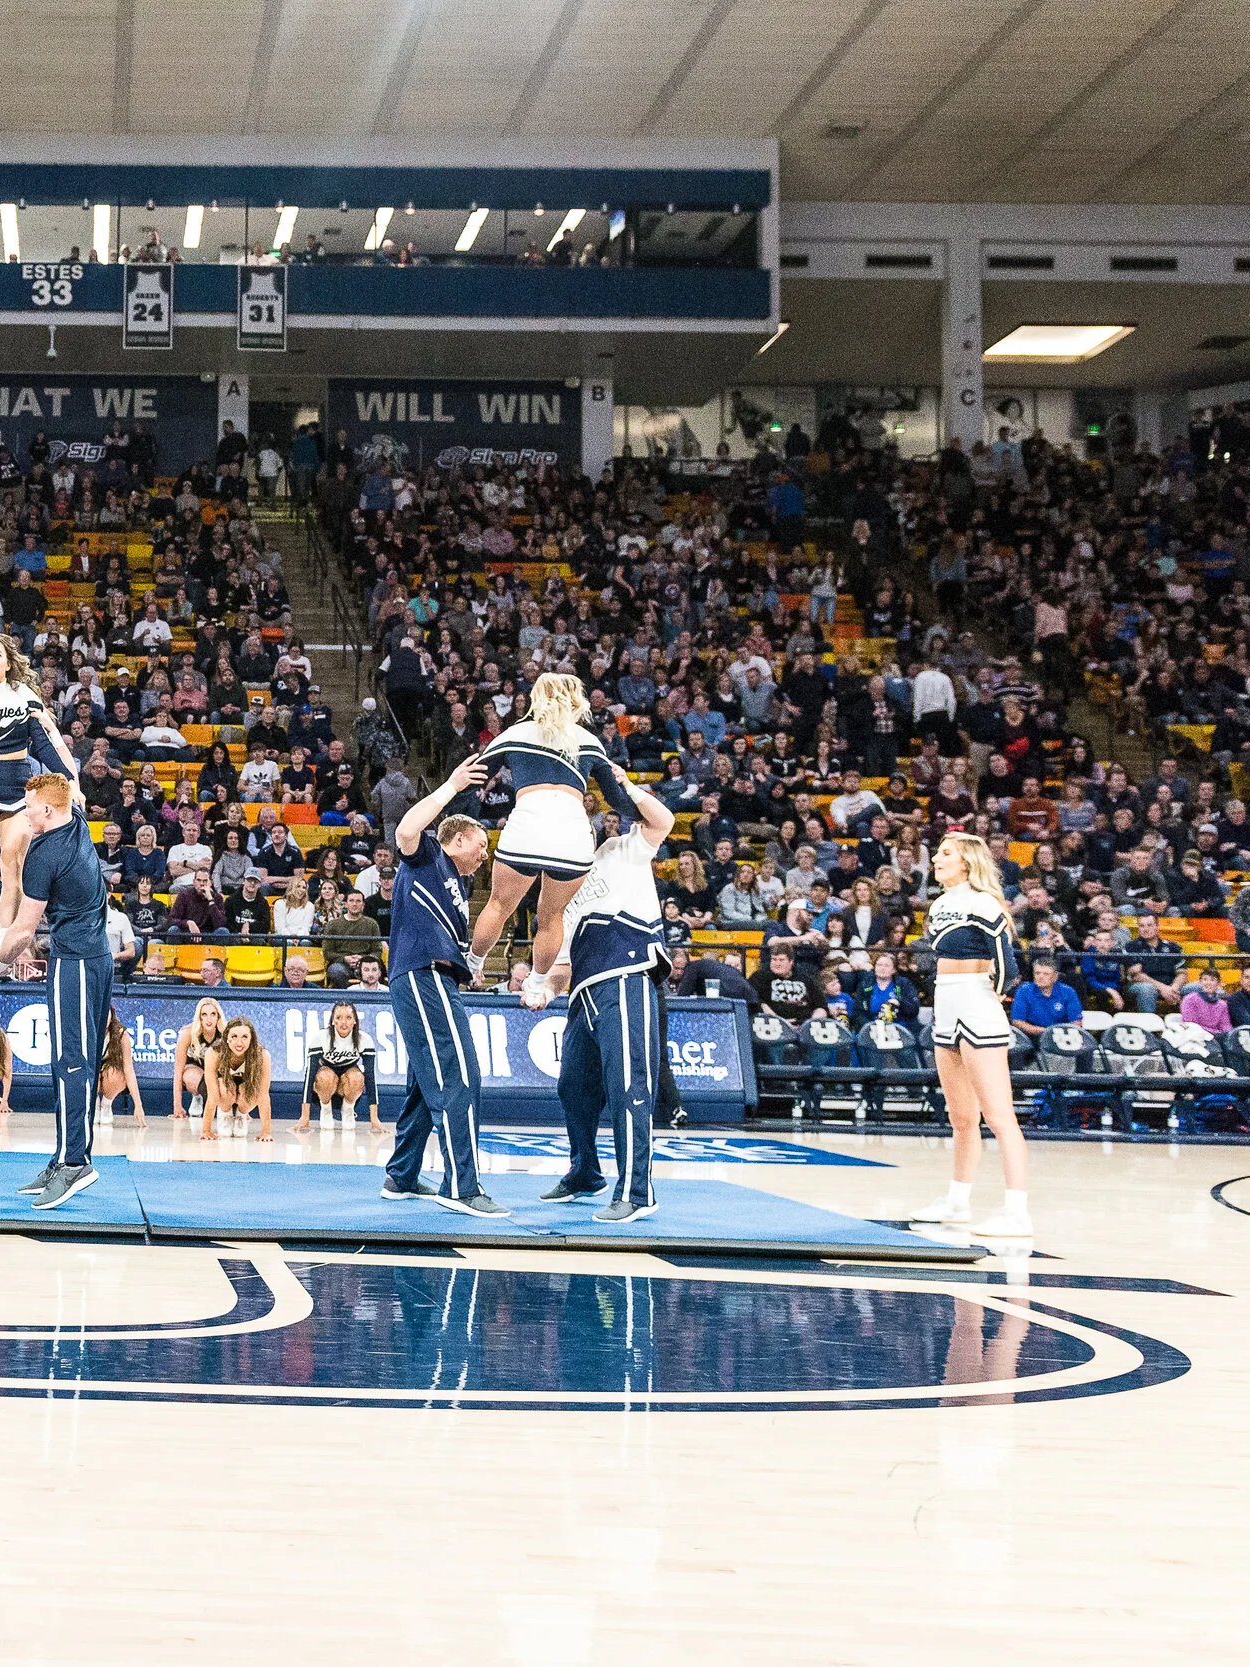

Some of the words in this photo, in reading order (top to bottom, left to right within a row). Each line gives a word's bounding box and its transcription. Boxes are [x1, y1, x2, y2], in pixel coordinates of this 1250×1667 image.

[22, 264, 84, 280] ESTES
[31, 280, 72, 305] 33
[133, 303, 163, 322] 24
[249, 304, 276, 323] 31
[227, 380, 241, 396] A
[591, 385, 605, 401] B
[960, 388, 976, 406] C
[93, 387, 158, 419] WE
[355, 392, 455, 422] WILL
[478, 394, 561, 425] WIN
